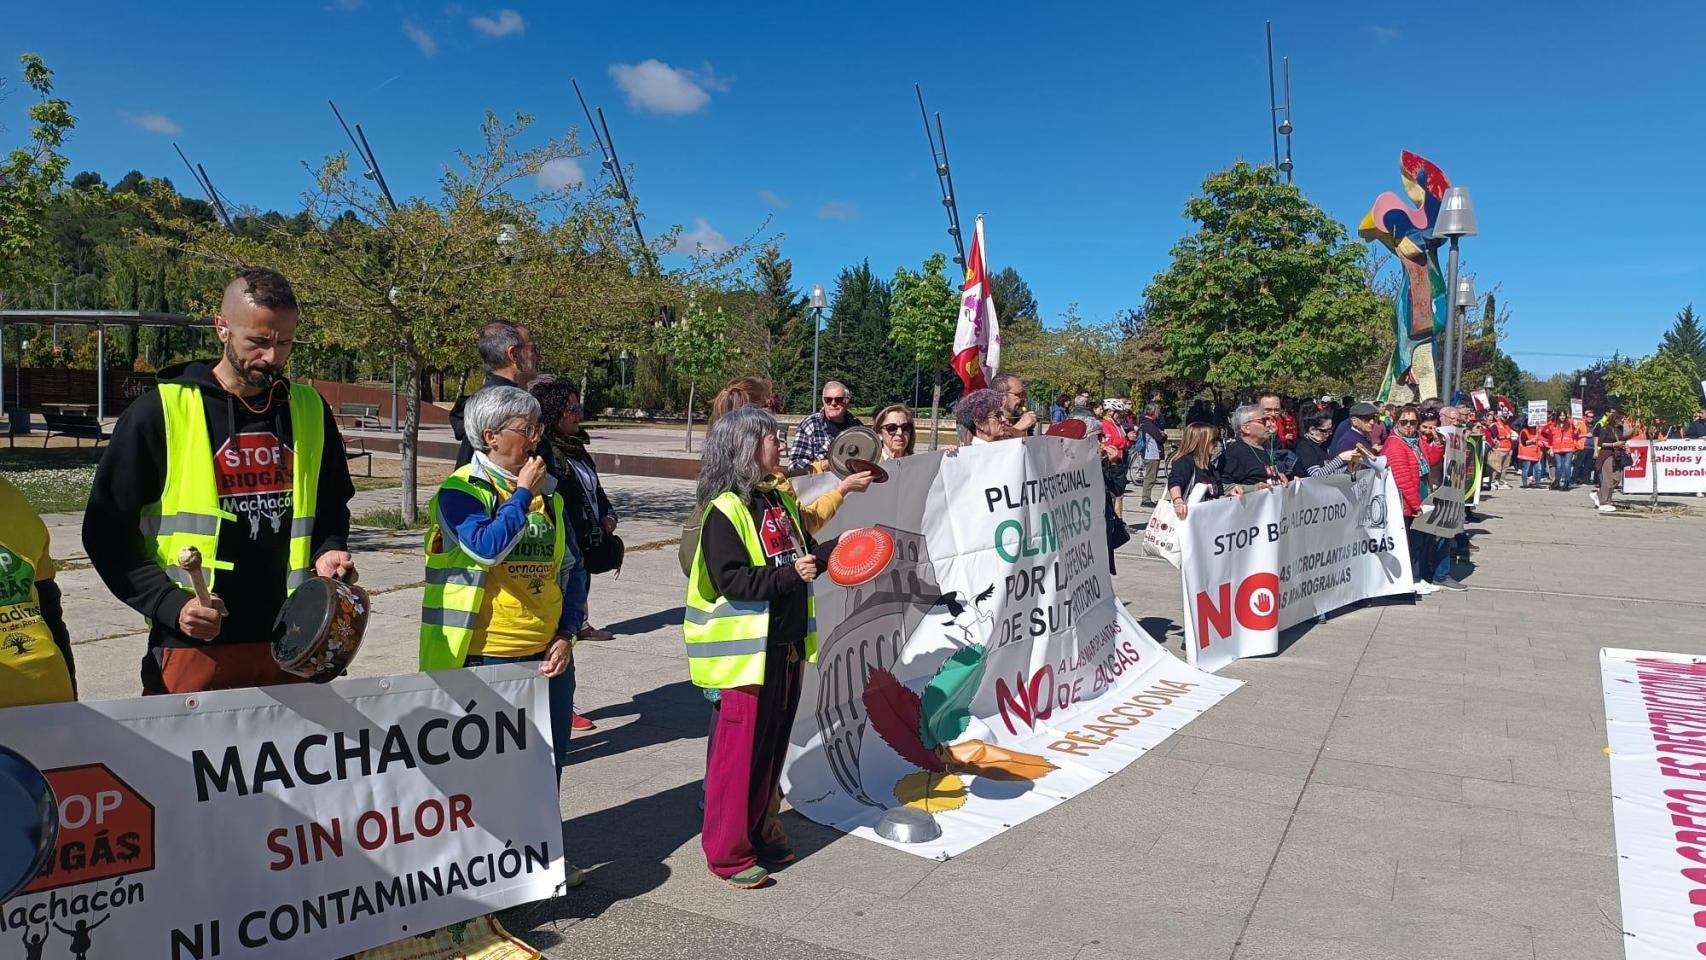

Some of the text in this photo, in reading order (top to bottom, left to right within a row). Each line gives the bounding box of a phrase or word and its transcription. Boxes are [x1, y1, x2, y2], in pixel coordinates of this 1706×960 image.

[222, 465, 291, 489] BIOGÁ
[1664, 467, 1706, 476] laboral
[1695, 455, 1702, 465] y
[1213, 526, 1260, 556] STOP
[1322, 502, 1347, 523] TORO
[1352, 534, 1395, 557] BIOGÁS
[1005, 565, 1046, 608] POR
[998, 612, 1023, 648] DE
[1029, 604, 1060, 637] SU
[1196, 572, 1279, 650] NO
[1058, 658, 1067, 675] A
[1069, 651, 1087, 671] LAS
[995, 663, 1055, 736] NO
[1058, 677, 1084, 710] DE
[1046, 677, 1201, 757] REACCIONA
[192, 700, 528, 803] MACHACÓN
[59, 789, 123, 830] OP
[266, 793, 477, 872] SIN OLOR
[170, 840, 550, 960] NI CONTAMINACIÓN
